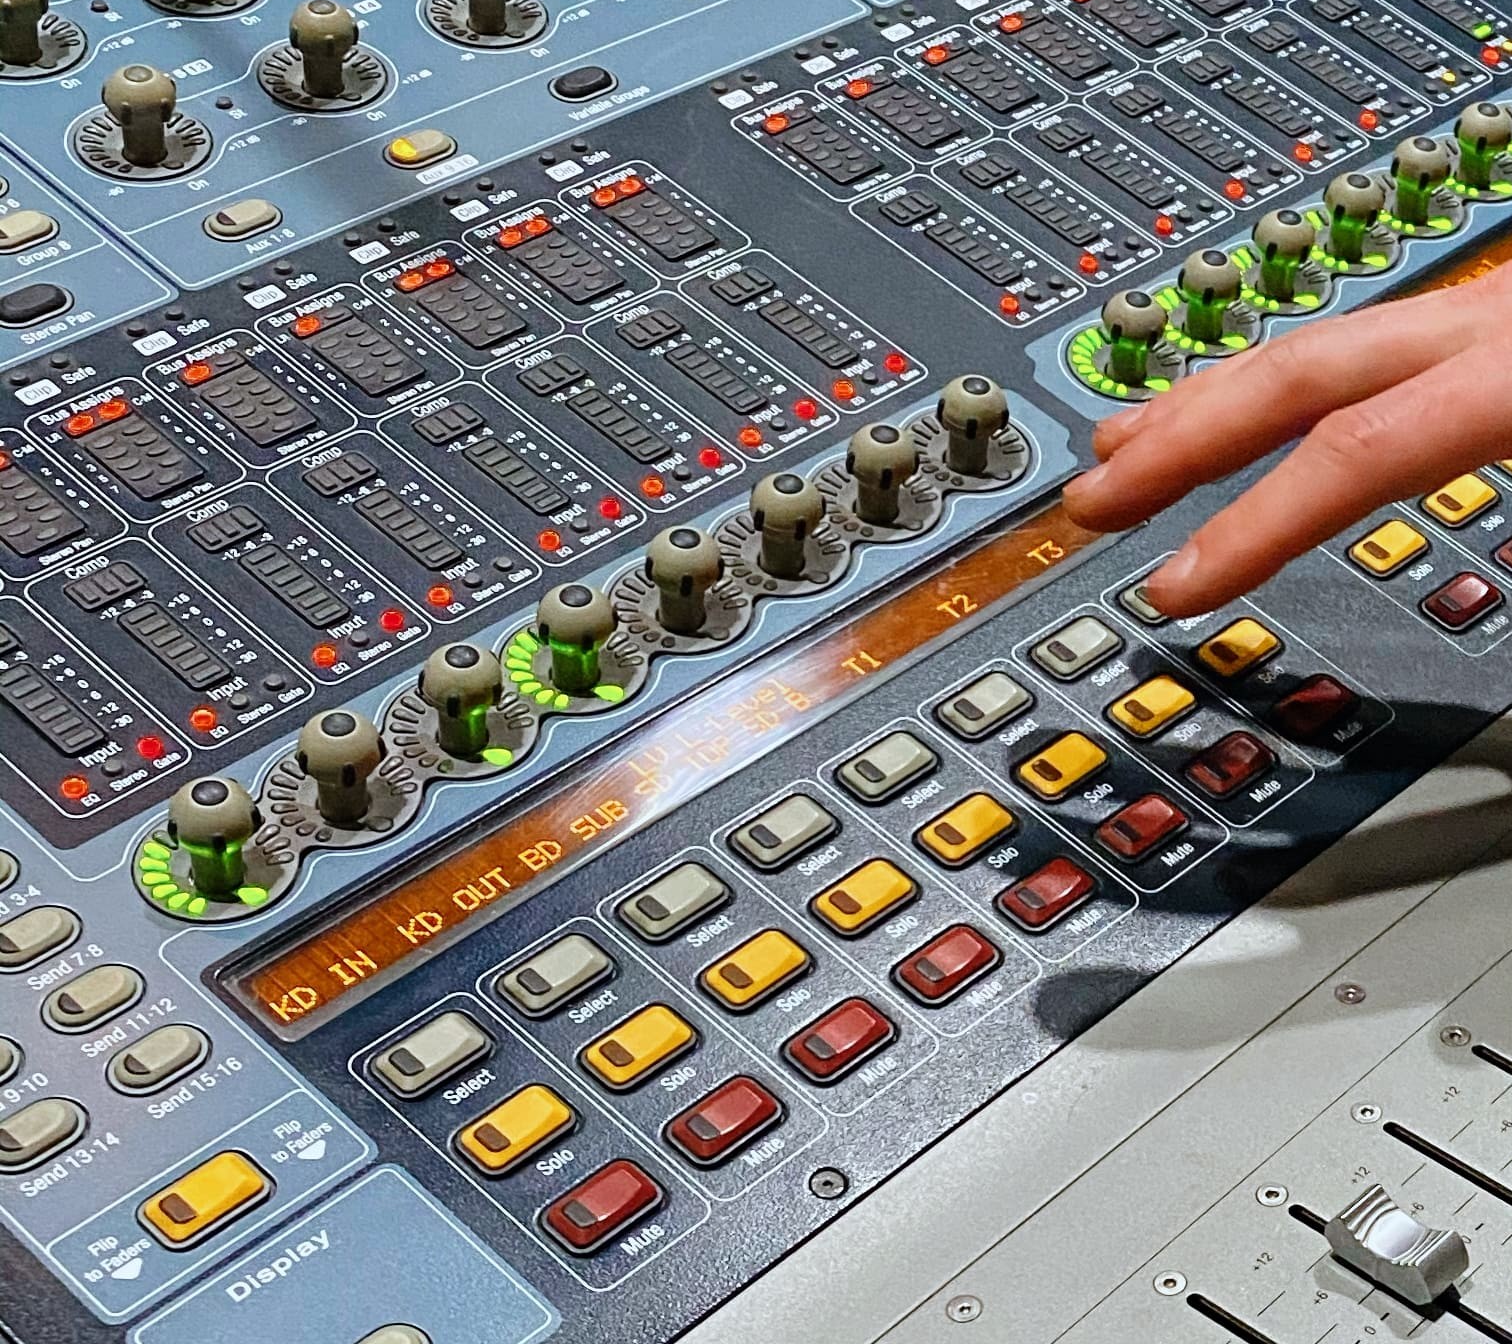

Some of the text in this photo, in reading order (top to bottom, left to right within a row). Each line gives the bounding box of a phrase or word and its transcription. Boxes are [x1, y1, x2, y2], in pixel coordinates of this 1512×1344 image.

[487, 188, 518, 206] Safe
[246, 237, 273, 255] Aux
[390, 229, 420, 249] Safe
[17, 245, 59, 266] Group
[285, 272, 318, 291] Safe
[20, 311, 96, 344] Stereo Pan
[177, 317, 210, 337] Safe
[61, 365, 96, 385] Safe
[651, 452, 688, 475] Input
[548, 503, 587, 525] Input
[1481, 514, 1505, 532] Solo
[440, 556, 480, 582] Input
[1409, 562, 1434, 581] Solo
[326, 613, 368, 641] Input
[1481, 614, 1510, 636] Mute
[1090, 660, 1131, 688] Select
[205, 674, 249, 703] Input
[999, 719, 1040, 748] Select
[1173, 720, 1202, 743] Solo
[78, 740, 123, 770] Input
[269, 539, 1065, 1022] KD IN KD OUT BD SUB T1 T2 T3
[1084, 781, 1114, 804] Solo
[1249, 777, 1282, 803] Mute
[902, 781, 945, 810] Select
[797, 848, 842, 878] Select
[988, 845, 1020, 870] Solo
[1160, 842, 1195, 868] Mute
[686, 915, 736, 949] Select
[885, 914, 919, 940] Solo
[27, 957, 71, 992] Send
[568, 987, 619, 1024] Select
[776, 987, 811, 1014] Solo
[81, 1021, 127, 1058] Send
[660, 1065, 698, 1093] Solo
[857, 1054, 898, 1086] Mute
[443, 1067, 497, 1107] Select
[147, 1083, 195, 1120] Send
[270, 1120, 333, 1164] to Faders
[273, 1118, 302, 1140] Flip
[536, 1146, 575, 1177] Solo
[742, 1135, 786, 1168] Mute
[19, 1161, 69, 1198] Send
[88, 1234, 119, 1256] Flip
[620, 1221, 666, 1256] Mute
[83, 1237, 151, 1283] to Faders
[225, 1228, 331, 1303] Display
[1252, 1251, 1275, 1272] +12
